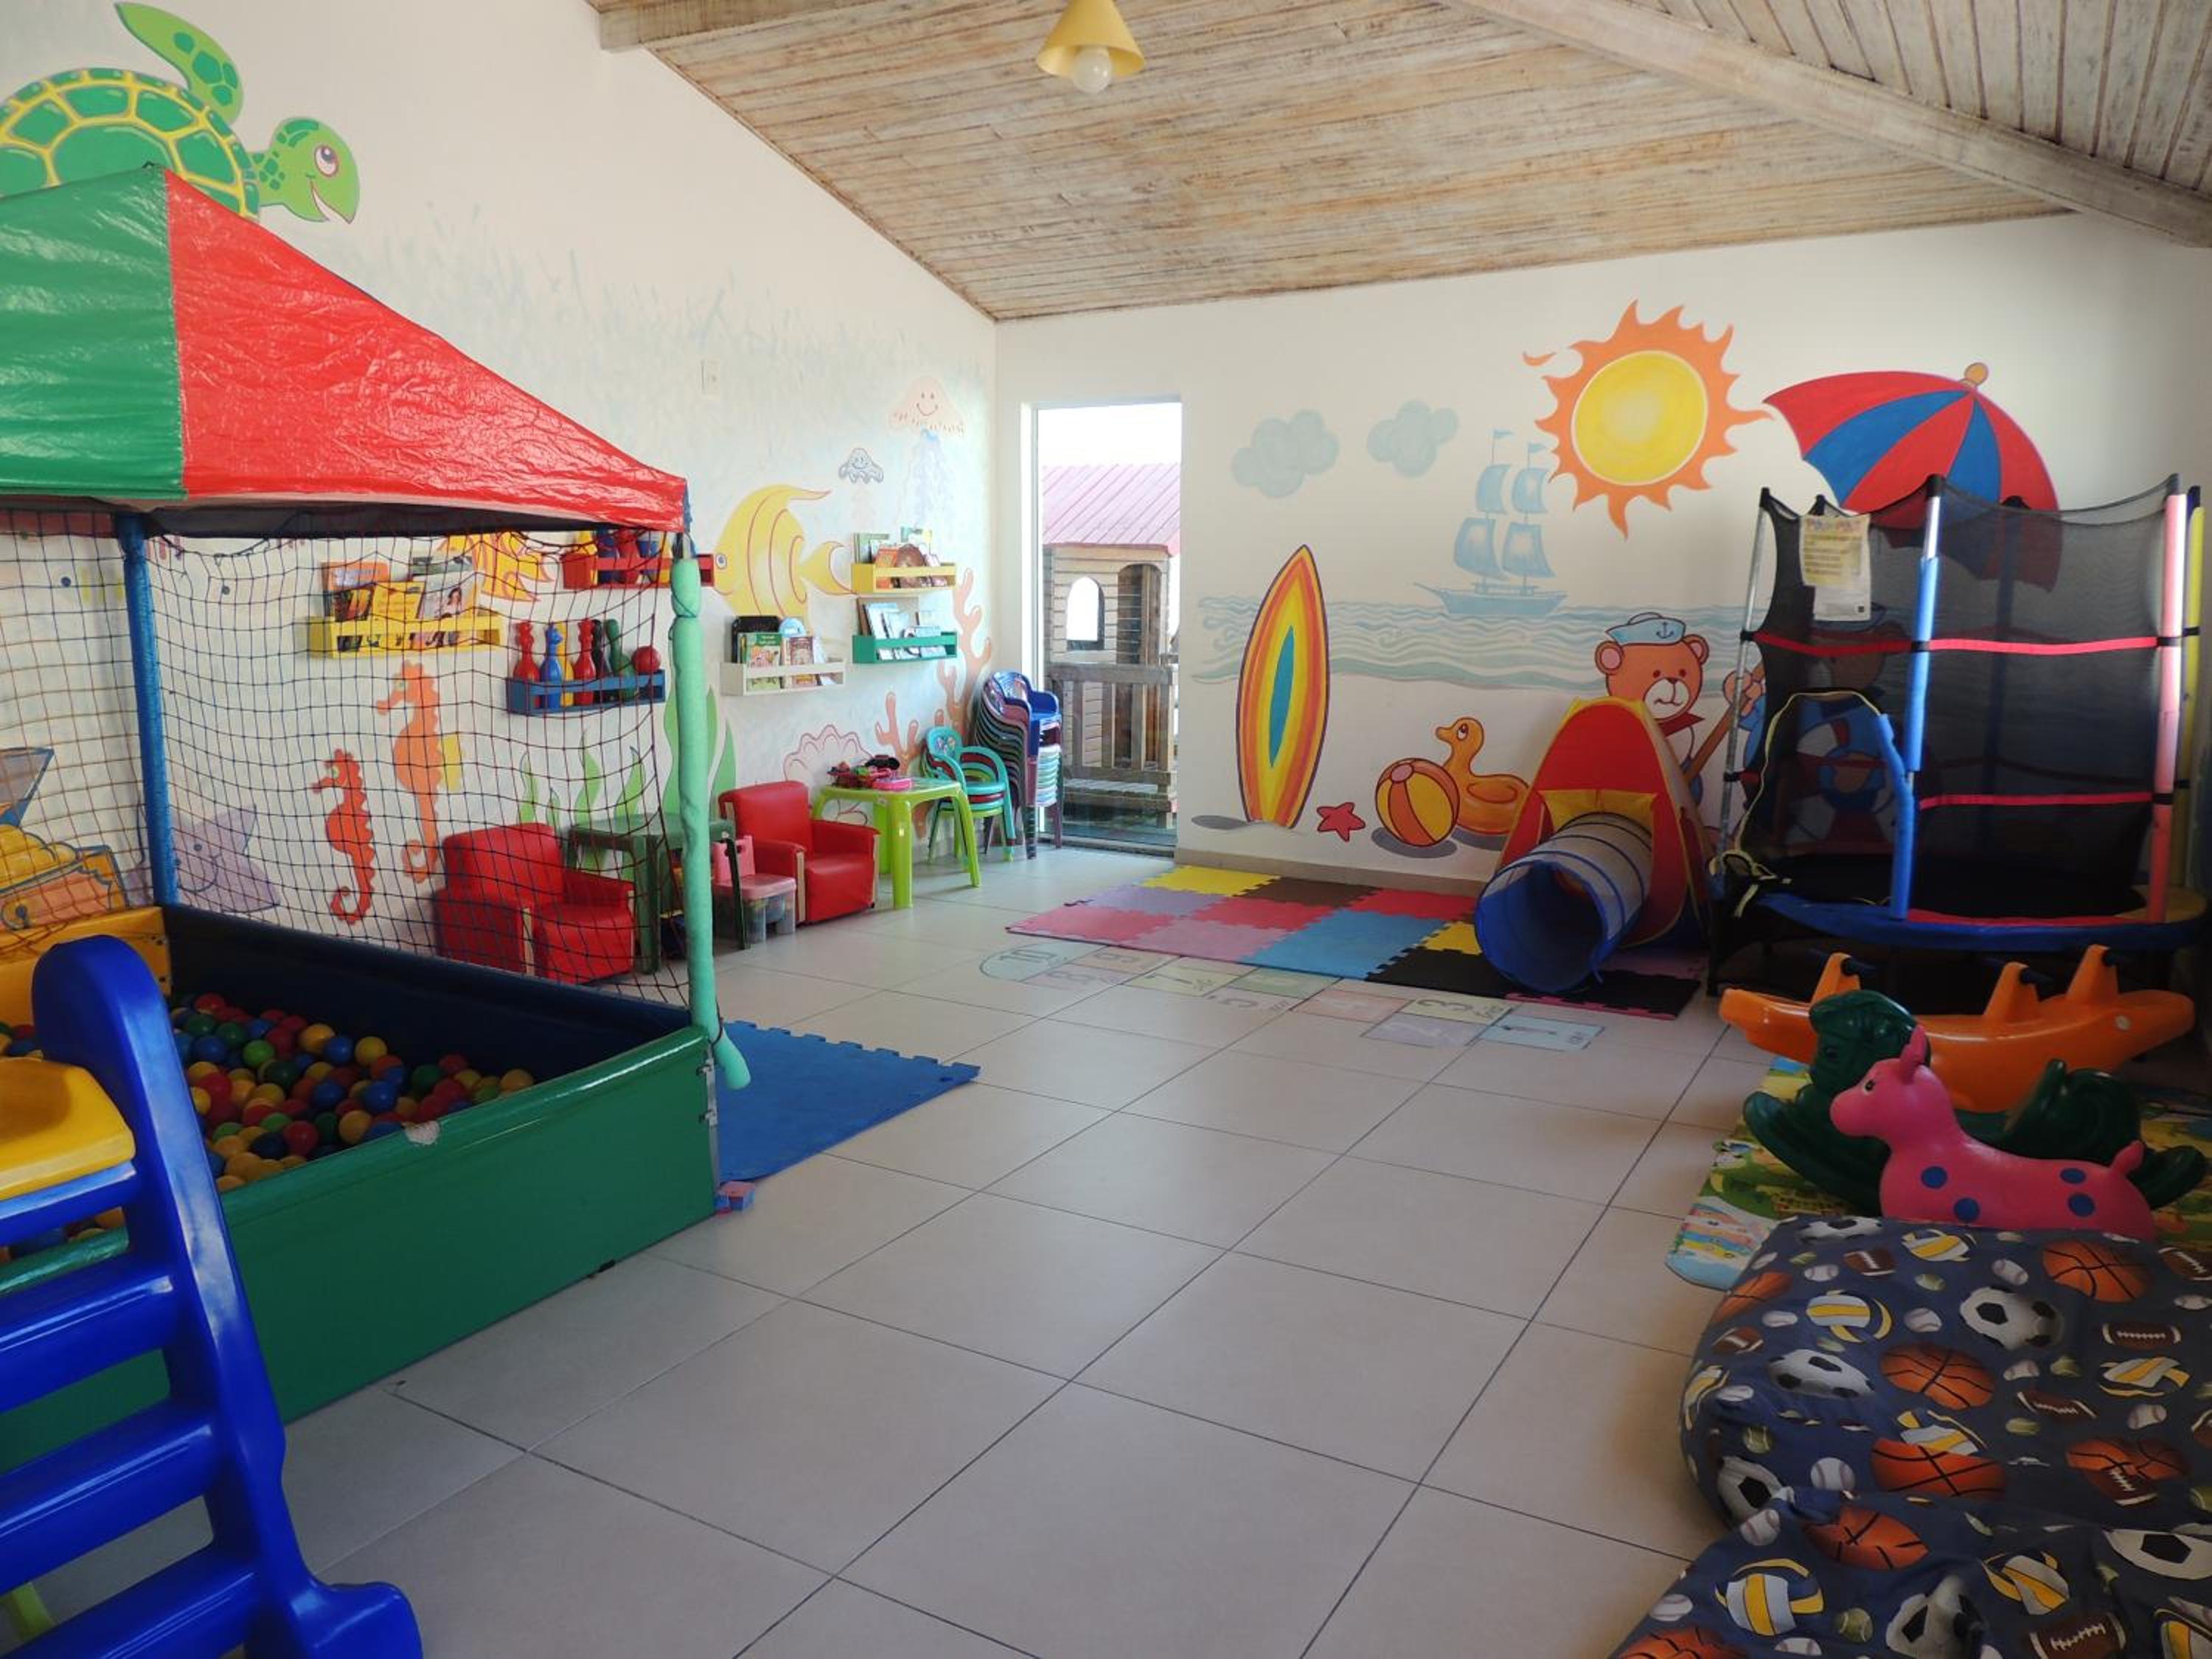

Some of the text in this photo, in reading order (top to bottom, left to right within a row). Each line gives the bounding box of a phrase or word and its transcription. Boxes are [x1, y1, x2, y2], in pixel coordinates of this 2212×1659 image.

[999, 949, 1059, 963] 10
[1416, 998, 1474, 1011] 3
[1500, 1024, 1557, 1035] 1
